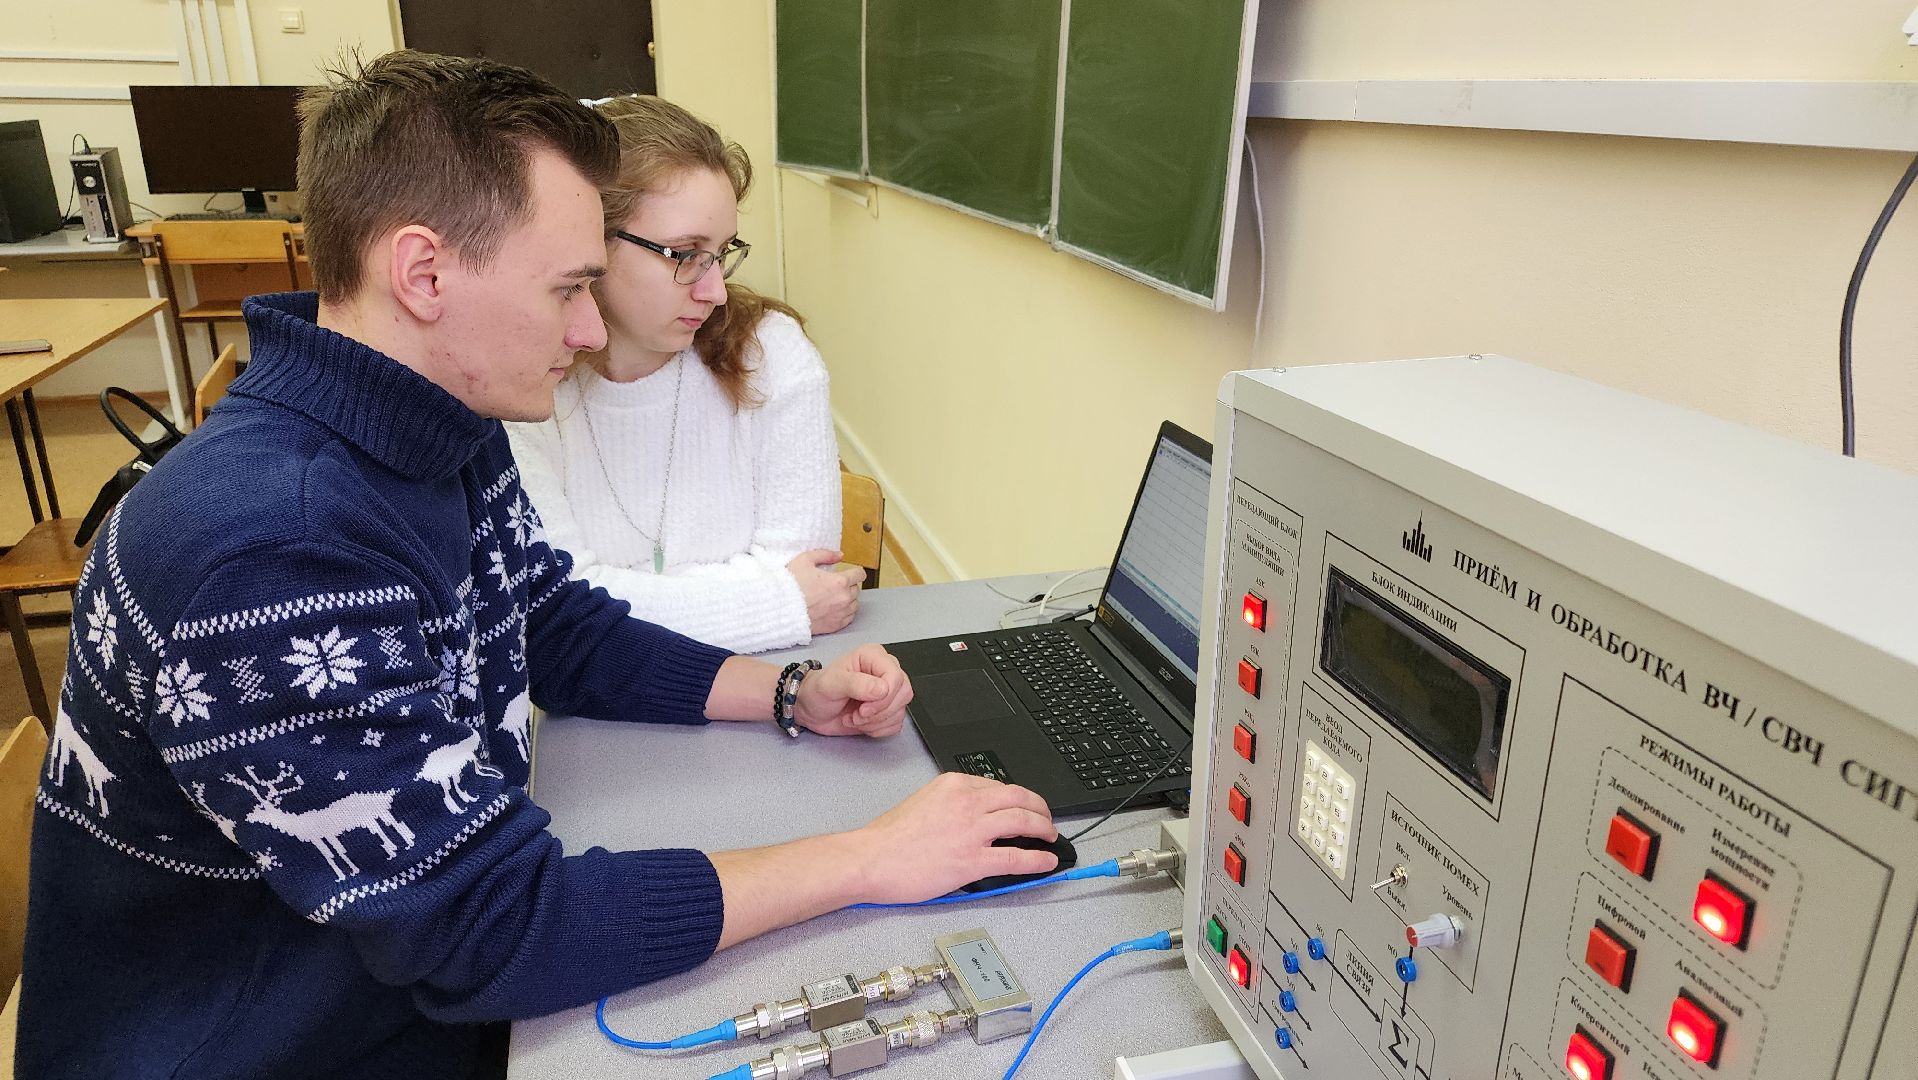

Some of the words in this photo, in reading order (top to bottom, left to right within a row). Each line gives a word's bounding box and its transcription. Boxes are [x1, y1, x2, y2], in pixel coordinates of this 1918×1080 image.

[1280, 522, 1298, 540] БЛОК
[1371, 570, 1396, 594] БЛОК
[1396, 585, 1458, 633] ИНДИКАЦИИ
[1452, 549, 1518, 600] ПРИЁМ
[1525, 588, 1542, 613] И
[1551, 603, 1688, 694] ОБРАБОТКА
[1701, 682, 1741, 721] ВЧ
[1761, 716, 1825, 766] СВЧ
[1840, 759, 1918, 823] СИГ
[1305, 708, 1363, 764] ПЕРЕДАВАЕМОГО
[1325, 712, 1343, 734] ВВОД
[1607, 776, 1686, 834] Декодирование
[1639, 734, 1715, 791] РЕЖИМЫ
[1719, 782, 1791, 838] РАБОТЫ
[1391, 809, 1442, 862] ИСТОЧНИК
[1442, 855, 1480, 896] ПОМЕХ
[1712, 828, 1775, 877] Измерение
[1442, 885, 1473, 920] Уровень
[1598, 894, 1646, 940] Цифровой
[1346, 949, 1374, 987] ЛИНИЯ
[1346, 963, 1371, 997] СВЯЗИ
[1571, 995, 1631, 1056] Когерентный
